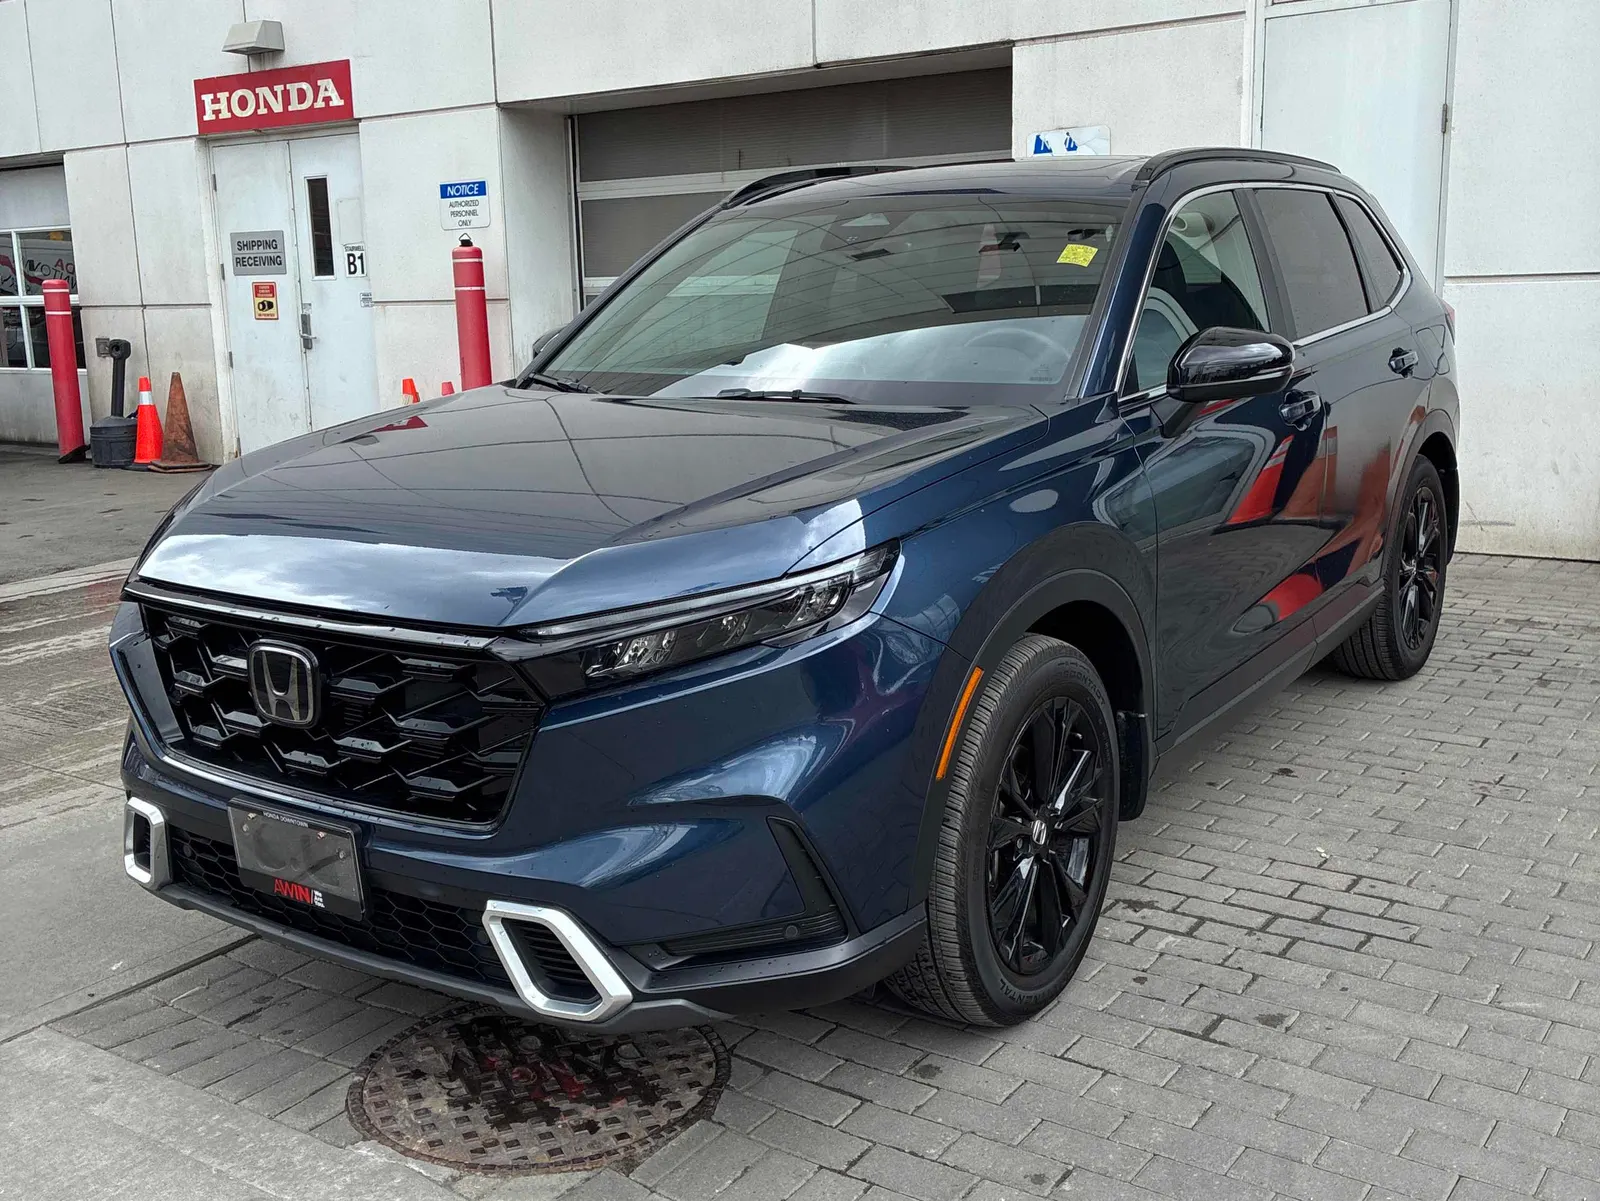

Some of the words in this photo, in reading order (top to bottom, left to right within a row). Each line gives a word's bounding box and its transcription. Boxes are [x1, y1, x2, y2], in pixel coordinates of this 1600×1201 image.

[201, 78, 344, 121] HONDA
[447, 183, 479, 196] NOTICE
[449, 199, 479, 208] AUTHORIZED
[450, 209, 479, 217] PERSONNEL
[458, 219, 472, 227] ONLY
[236, 239, 278, 251] SHIPPING
[235, 255, 282, 267] RECEIVING
[347, 252, 365, 275] B1
[262, 811, 280, 820] HONDA
[280, 815, 309, 828] DOWNTOWN
[274, 878, 311, 904] AWIN
